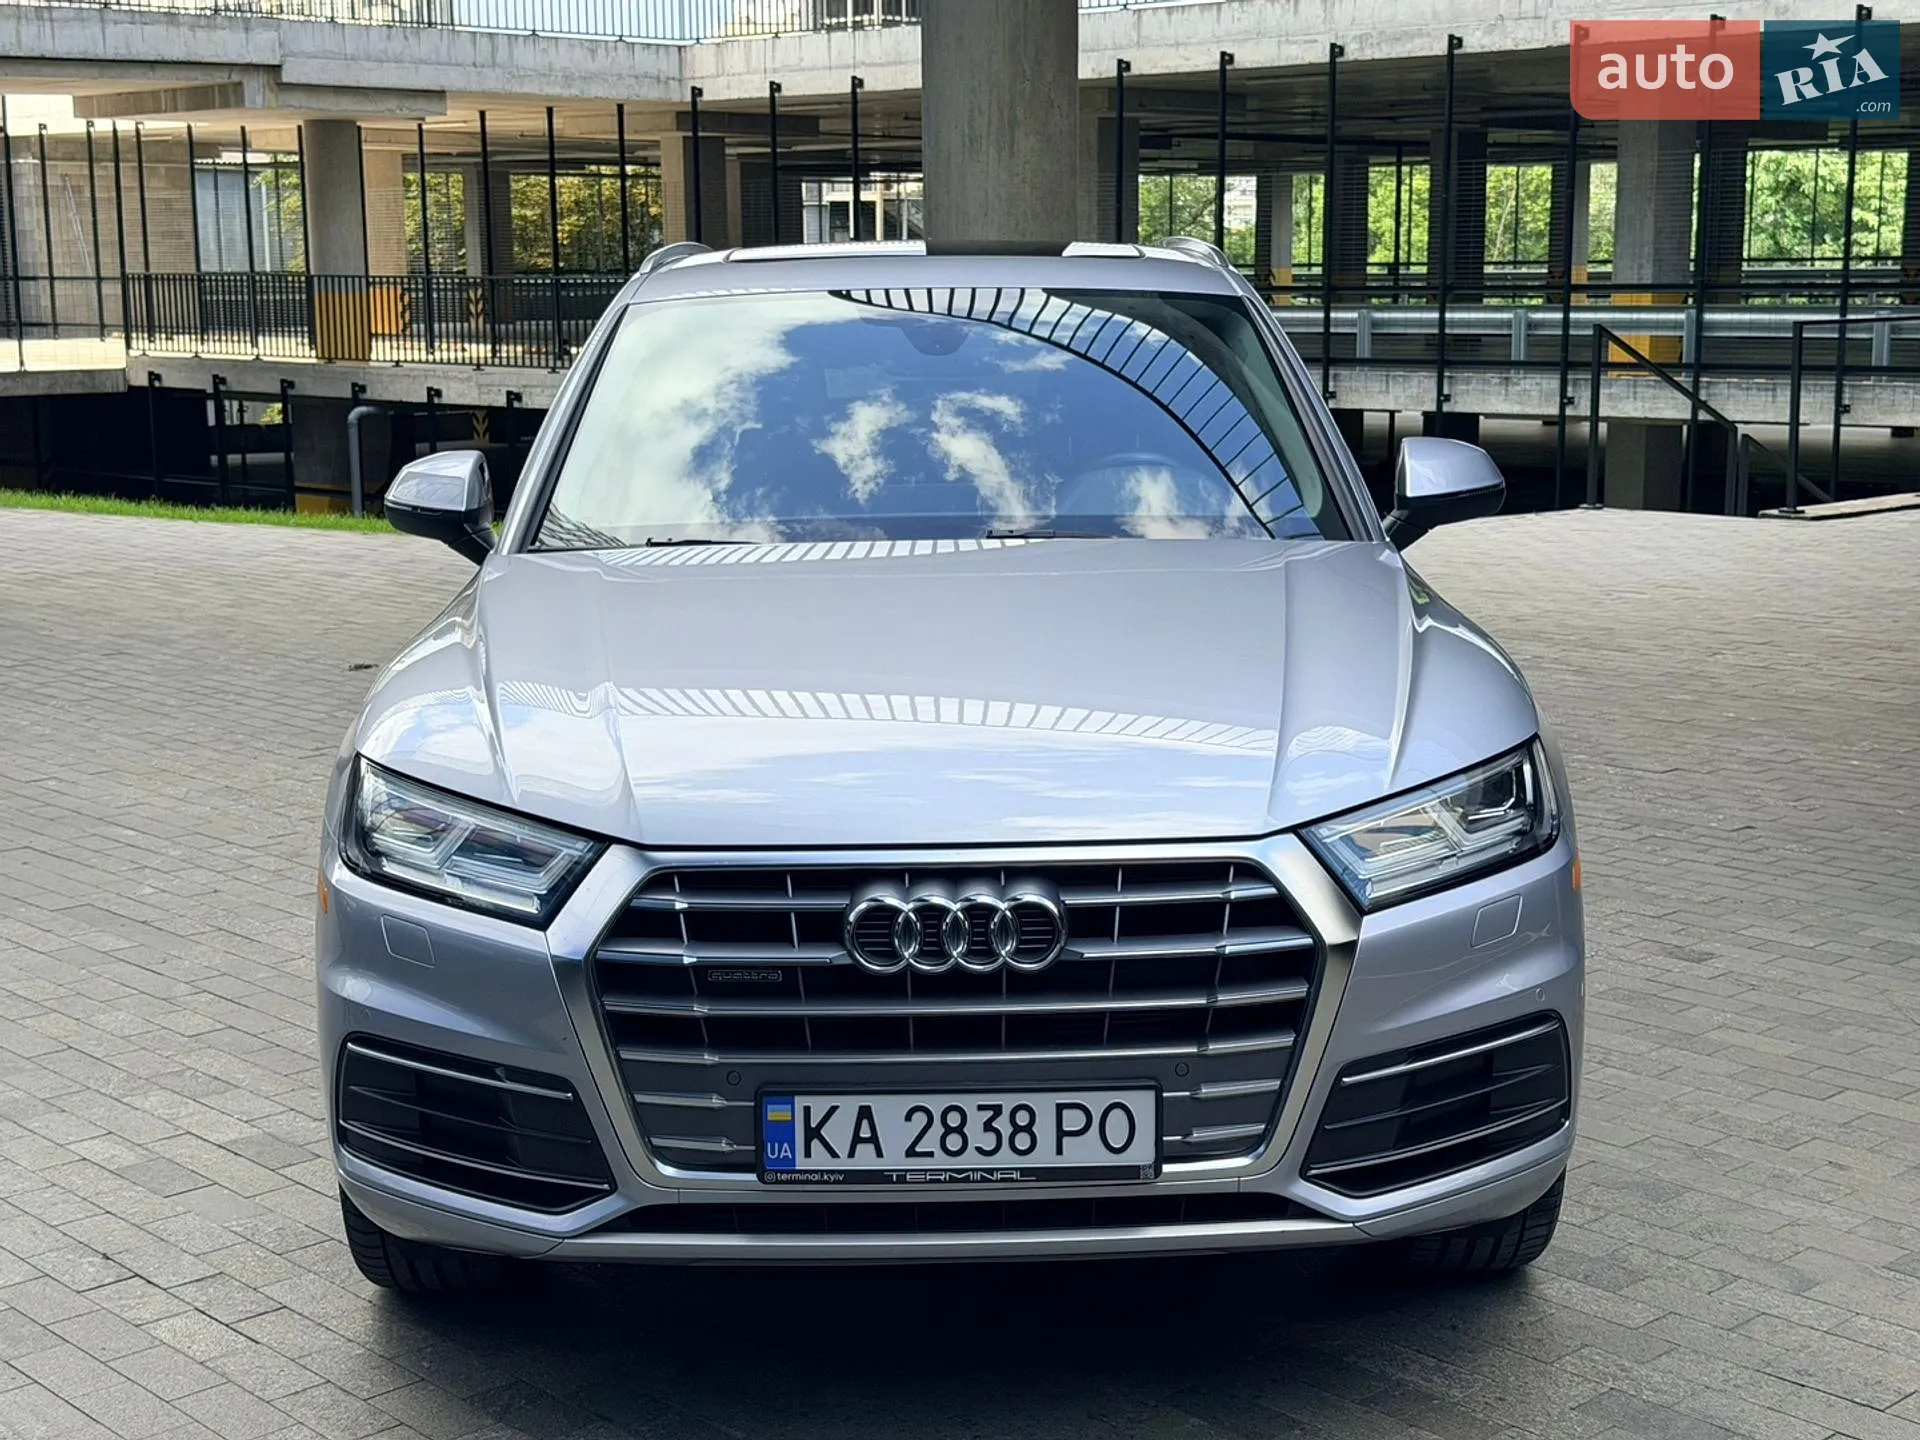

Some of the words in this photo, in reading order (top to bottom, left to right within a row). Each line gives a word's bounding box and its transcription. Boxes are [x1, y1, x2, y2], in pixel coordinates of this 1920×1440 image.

[802, 1104, 885, 1160] KA
[903, 1103, 1038, 1158] 2838
[1054, 1100, 1136, 1156] PO
[766, 1141, 793, 1160] UA
[883, 1170, 1038, 1183] TERMINAL
